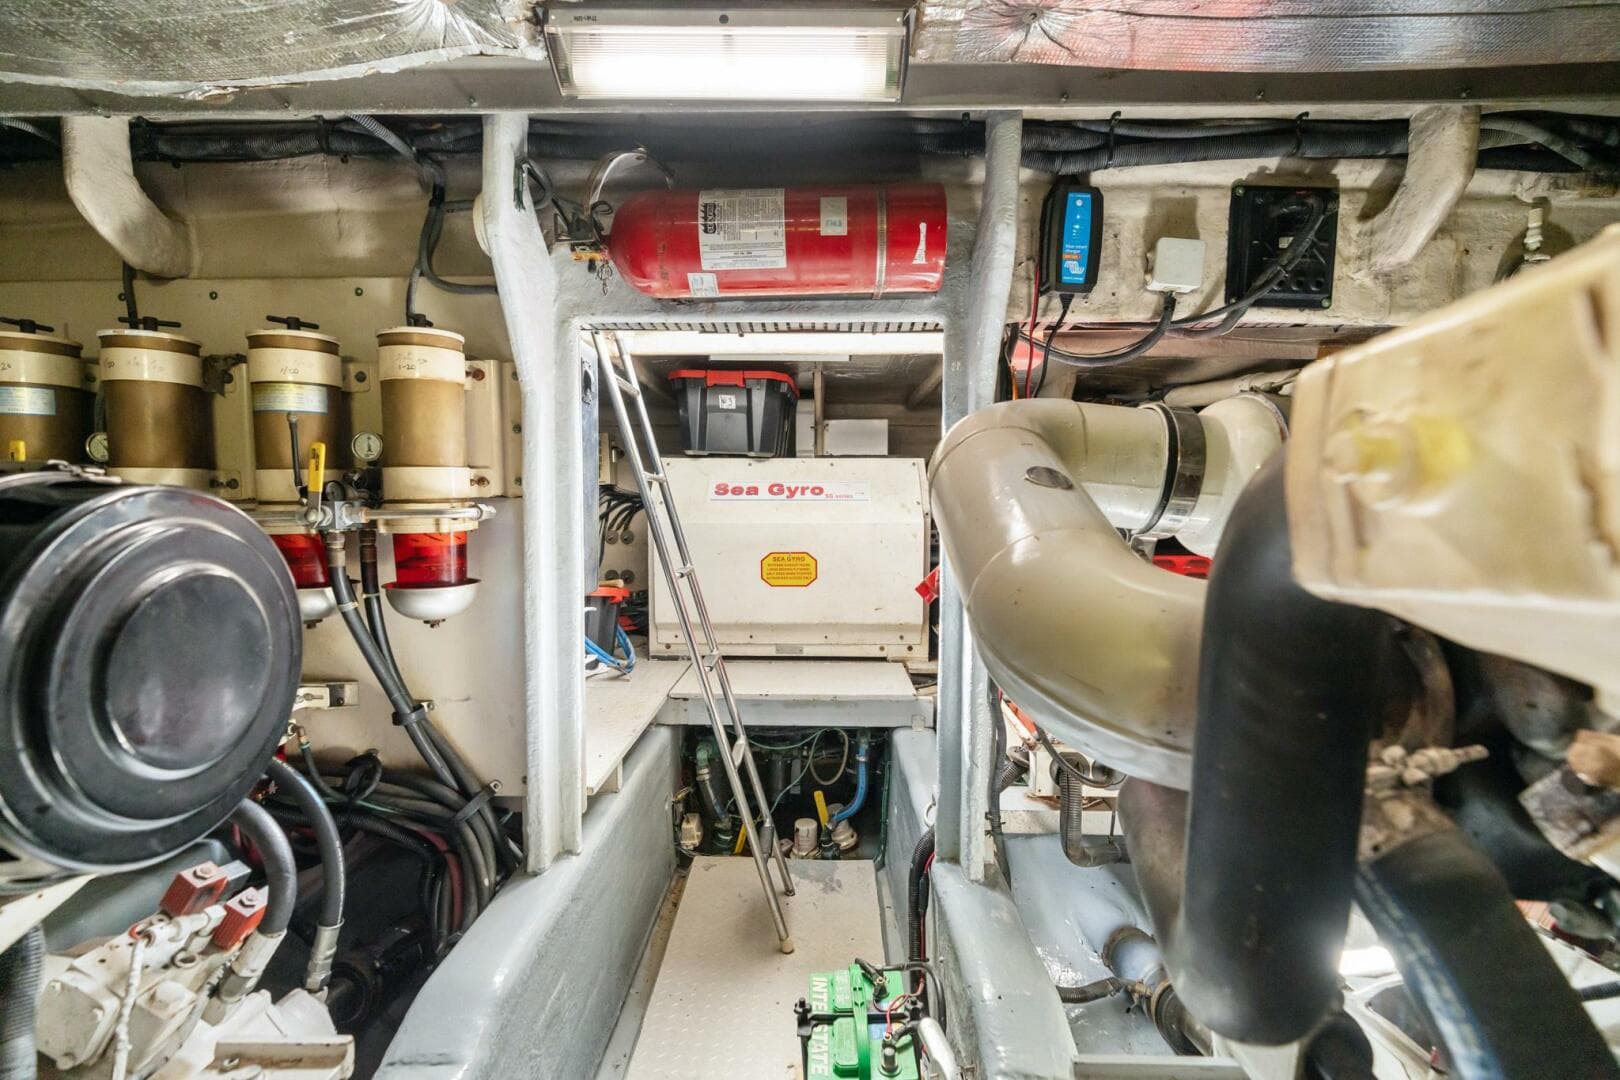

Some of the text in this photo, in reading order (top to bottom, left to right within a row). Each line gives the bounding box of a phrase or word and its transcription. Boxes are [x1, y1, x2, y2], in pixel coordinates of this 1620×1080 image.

[714, 483, 759, 496] Sea
[767, 483, 825, 499] Gyro
[812, 976, 829, 1076] INTESTATE
